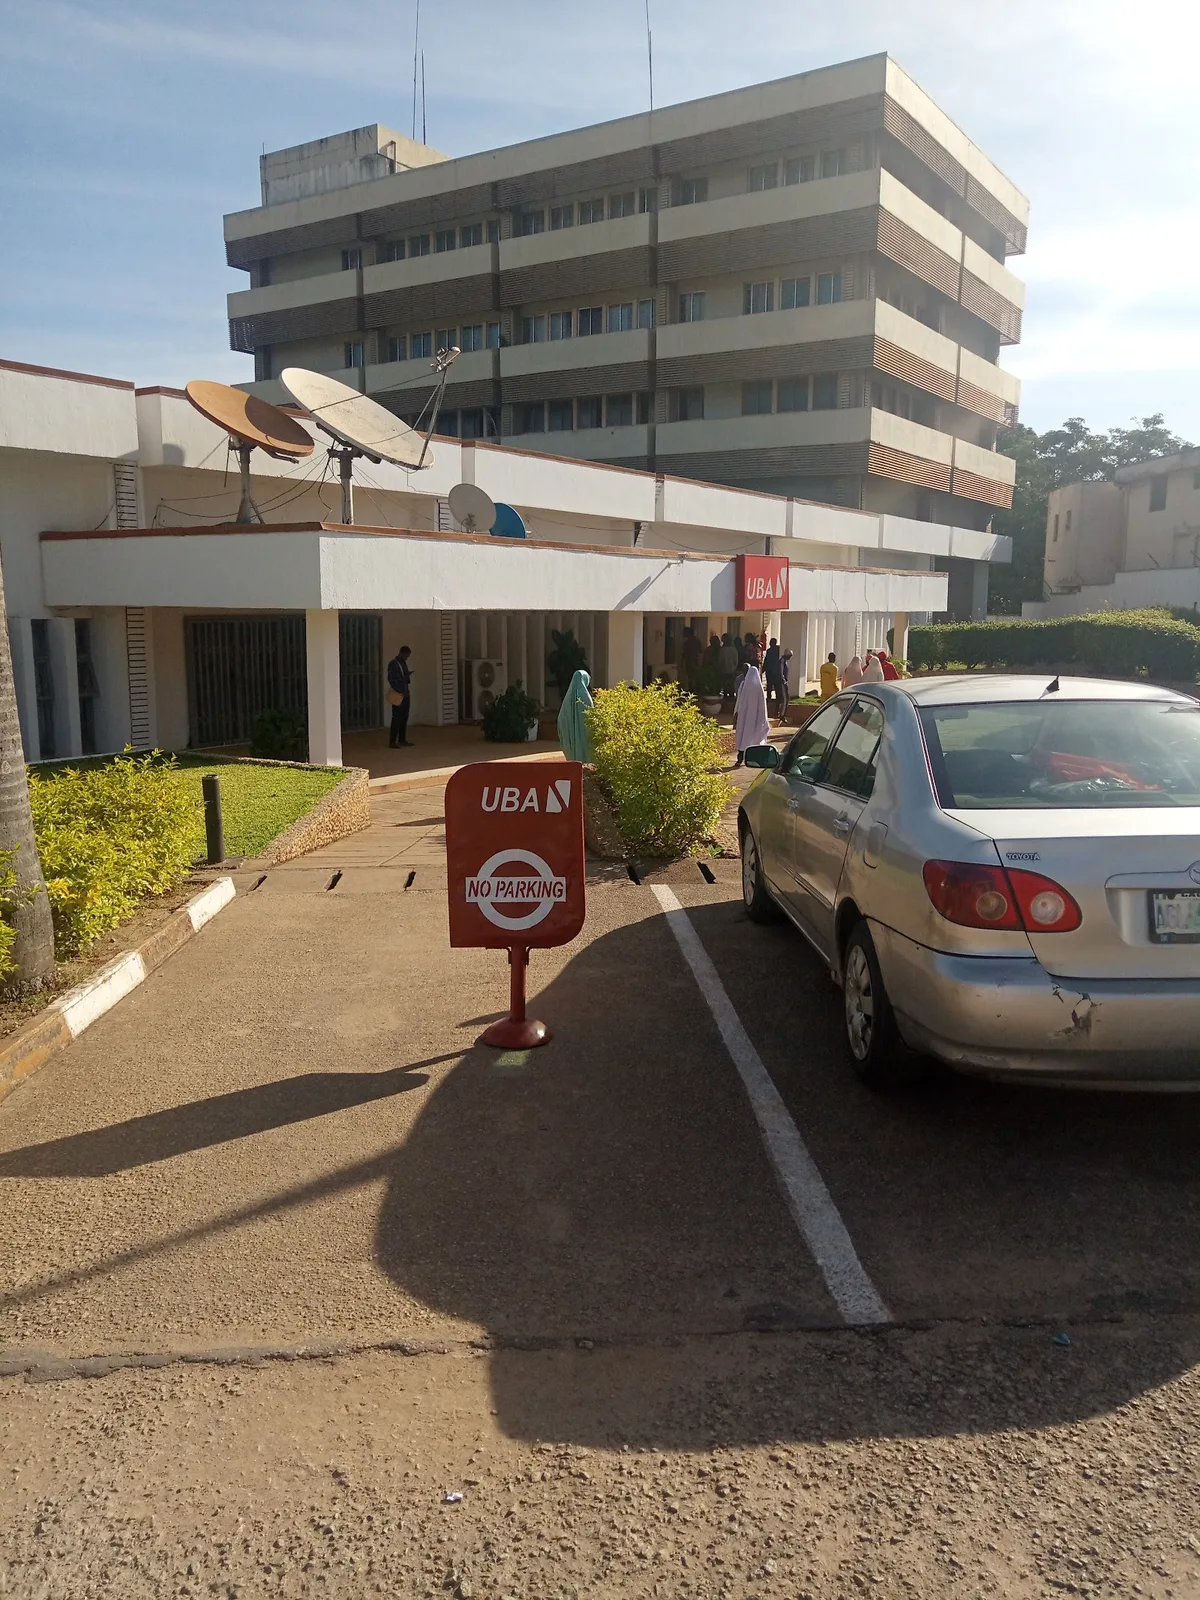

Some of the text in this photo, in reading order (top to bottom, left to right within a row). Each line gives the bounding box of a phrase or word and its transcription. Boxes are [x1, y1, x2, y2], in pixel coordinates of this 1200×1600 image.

[747, 577, 774, 600] UBA
[481, 787, 540, 813] UBA
[1006, 852, 1040, 861] TOYOTA
[468, 880, 564, 899] NO PARKING
